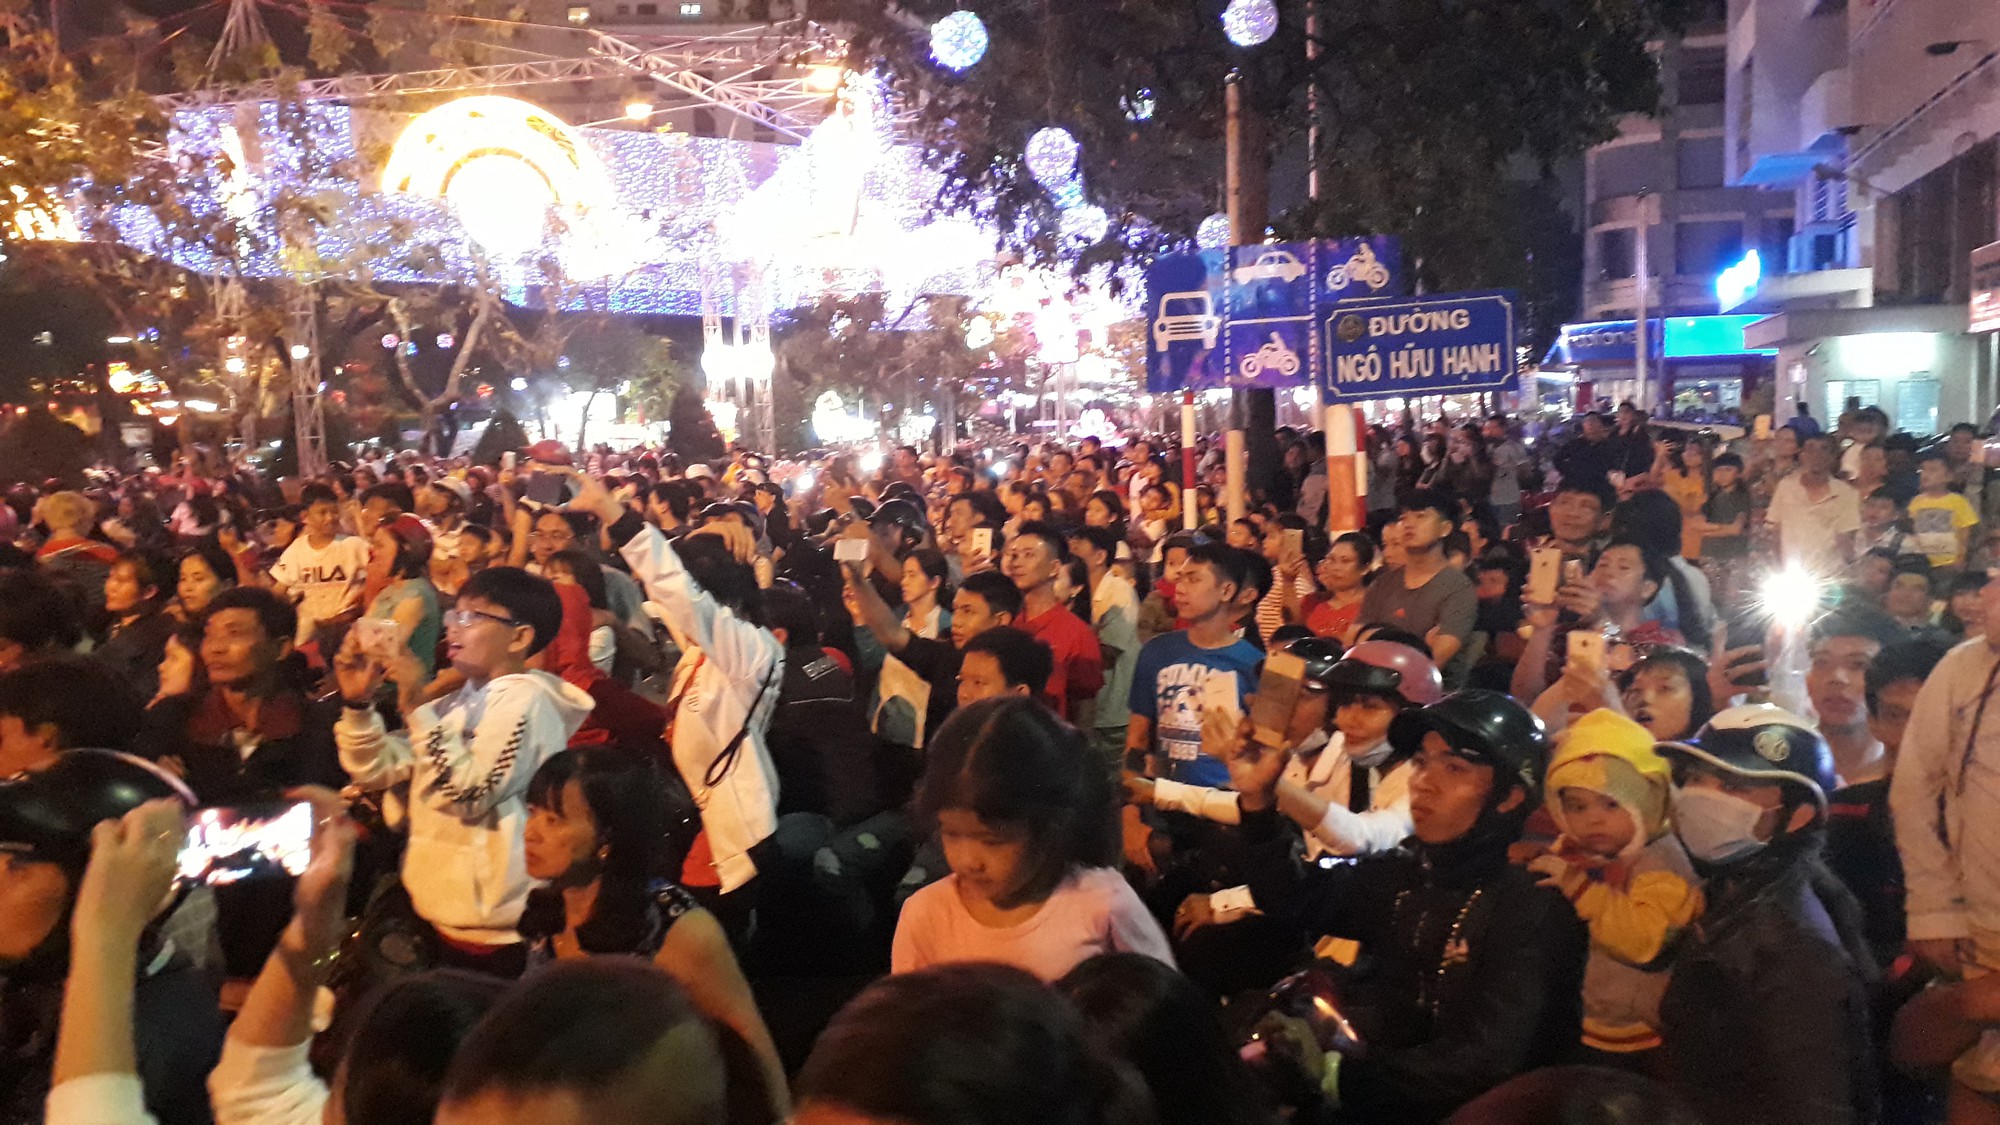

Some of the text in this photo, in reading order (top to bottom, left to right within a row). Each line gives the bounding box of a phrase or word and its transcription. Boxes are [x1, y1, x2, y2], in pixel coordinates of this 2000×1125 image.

[1368, 307, 1471, 337] ĐƯỜNG
[1336, 342, 1501, 384] NGÔ HỮU HẠNH
[302, 565, 347, 584] FILA
